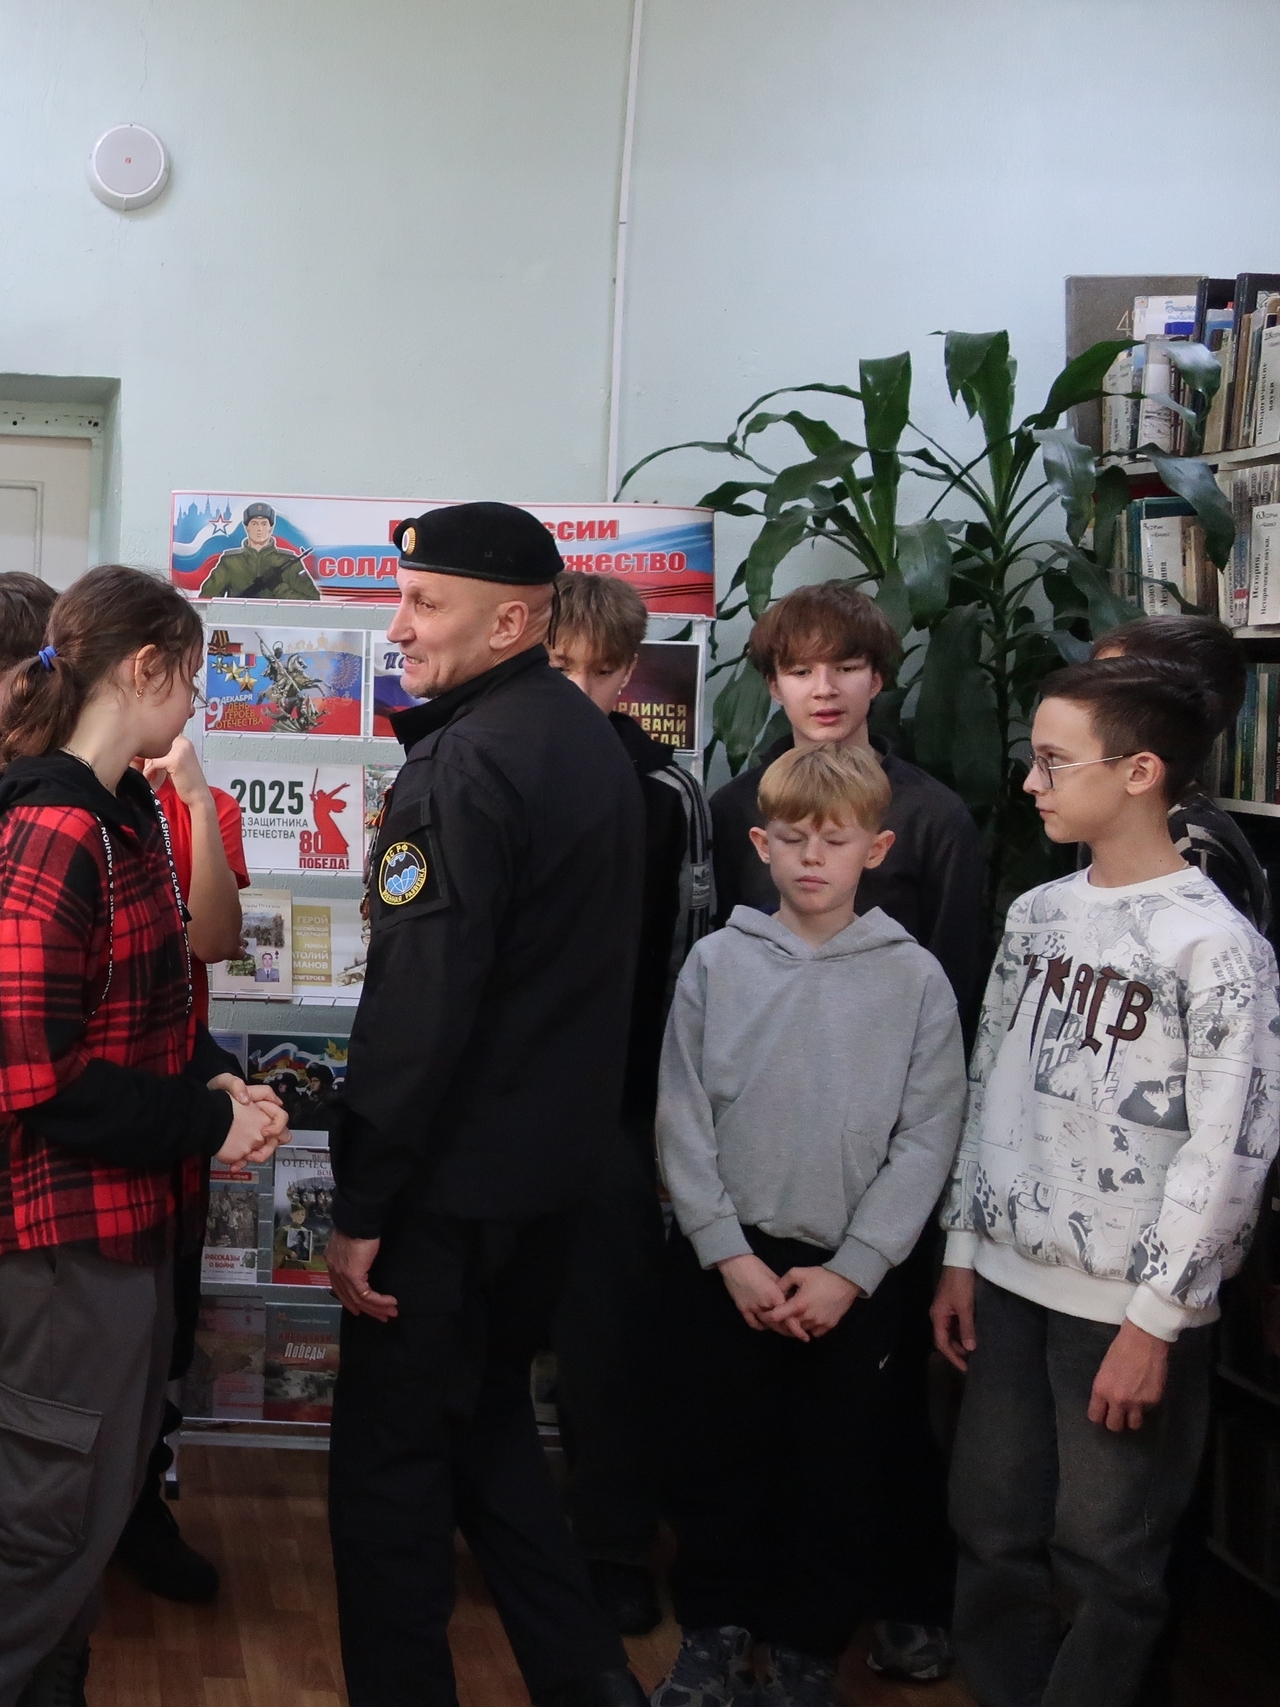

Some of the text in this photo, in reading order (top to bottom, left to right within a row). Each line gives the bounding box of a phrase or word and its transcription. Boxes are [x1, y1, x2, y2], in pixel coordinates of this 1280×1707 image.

[318, 550, 687, 580] солд жество
[206, 693, 253, 729] 9 ДЕКАБРЯ
[228, 701, 250, 711] ДЕНЬ
[618, 702, 687, 717] РДИМСЯ
[224, 709, 255, 720] ГЕРОЕВ
[215, 717, 263, 730] ОТЕЧЕСТВА
[642, 717, 687, 732] ВАМИ
[650, 733, 686, 748] ГДА!
[230, 778, 304, 816] 2025
[247, 817, 309, 828] ЗАЩИТНИКА
[299, 829, 324, 854] 80
[299, 857, 350, 870] ПОБЕДА!
[297, 914, 329, 924] ГЕРОЙ
[293, 950, 329, 960] ТОЛИЙ
[293, 961, 329, 969] МАНОВ
[282, 1158, 328, 1170] ОТЕЧЕС
[284, 1342, 327, 1361] Победы
